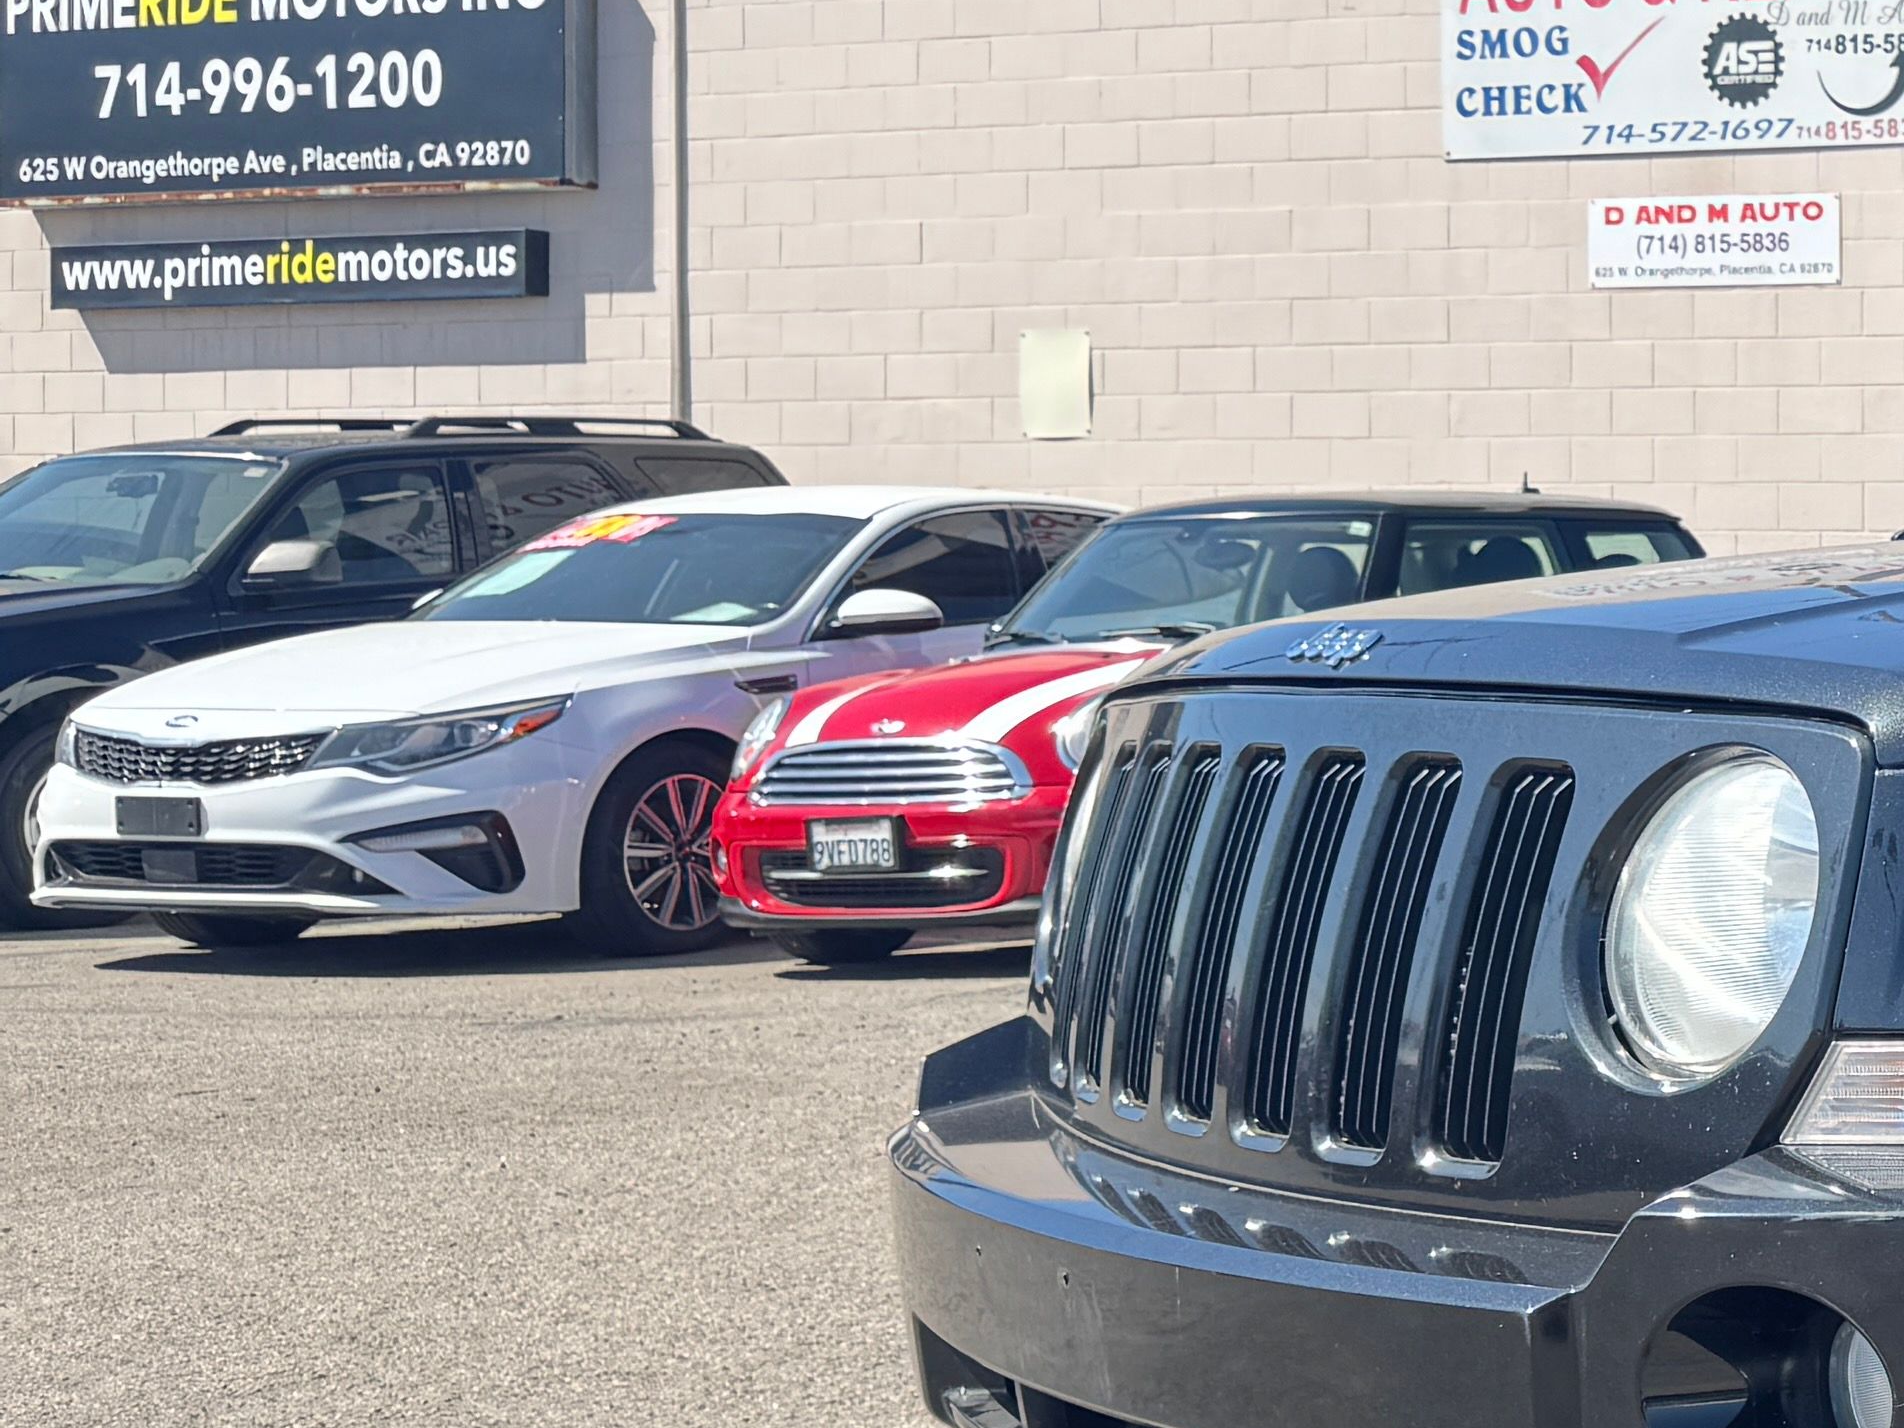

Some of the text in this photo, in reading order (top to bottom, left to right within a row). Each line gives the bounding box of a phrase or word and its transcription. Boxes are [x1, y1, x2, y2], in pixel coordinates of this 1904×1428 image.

[1796, 0, 1832, 26] and
[1838, 0, 1868, 26] M
[1456, 26, 1570, 60] SMOG
[1712, 39, 1776, 76] ASE
[94, 48, 443, 119] 714-996-1200
[1456, 82, 1588, 118] CHECK
[1581, 118, 1795, 146] 714-572-1697
[20, 156, 59, 183] 625
[63, 156, 86, 181] W
[90, 153, 240, 184] Orangethorpe
[419, 143, 452, 168] CA
[456, 140, 530, 167] 92870
[1604, 201, 1824, 225] D AND M AUTO
[1636, 232, 1790, 260] (714) 815-5836
[62, 239, 517, 299] www.primeridemotors.us
[1779, 262, 1796, 274] CA
[814, 838, 892, 865] 9VFD788
